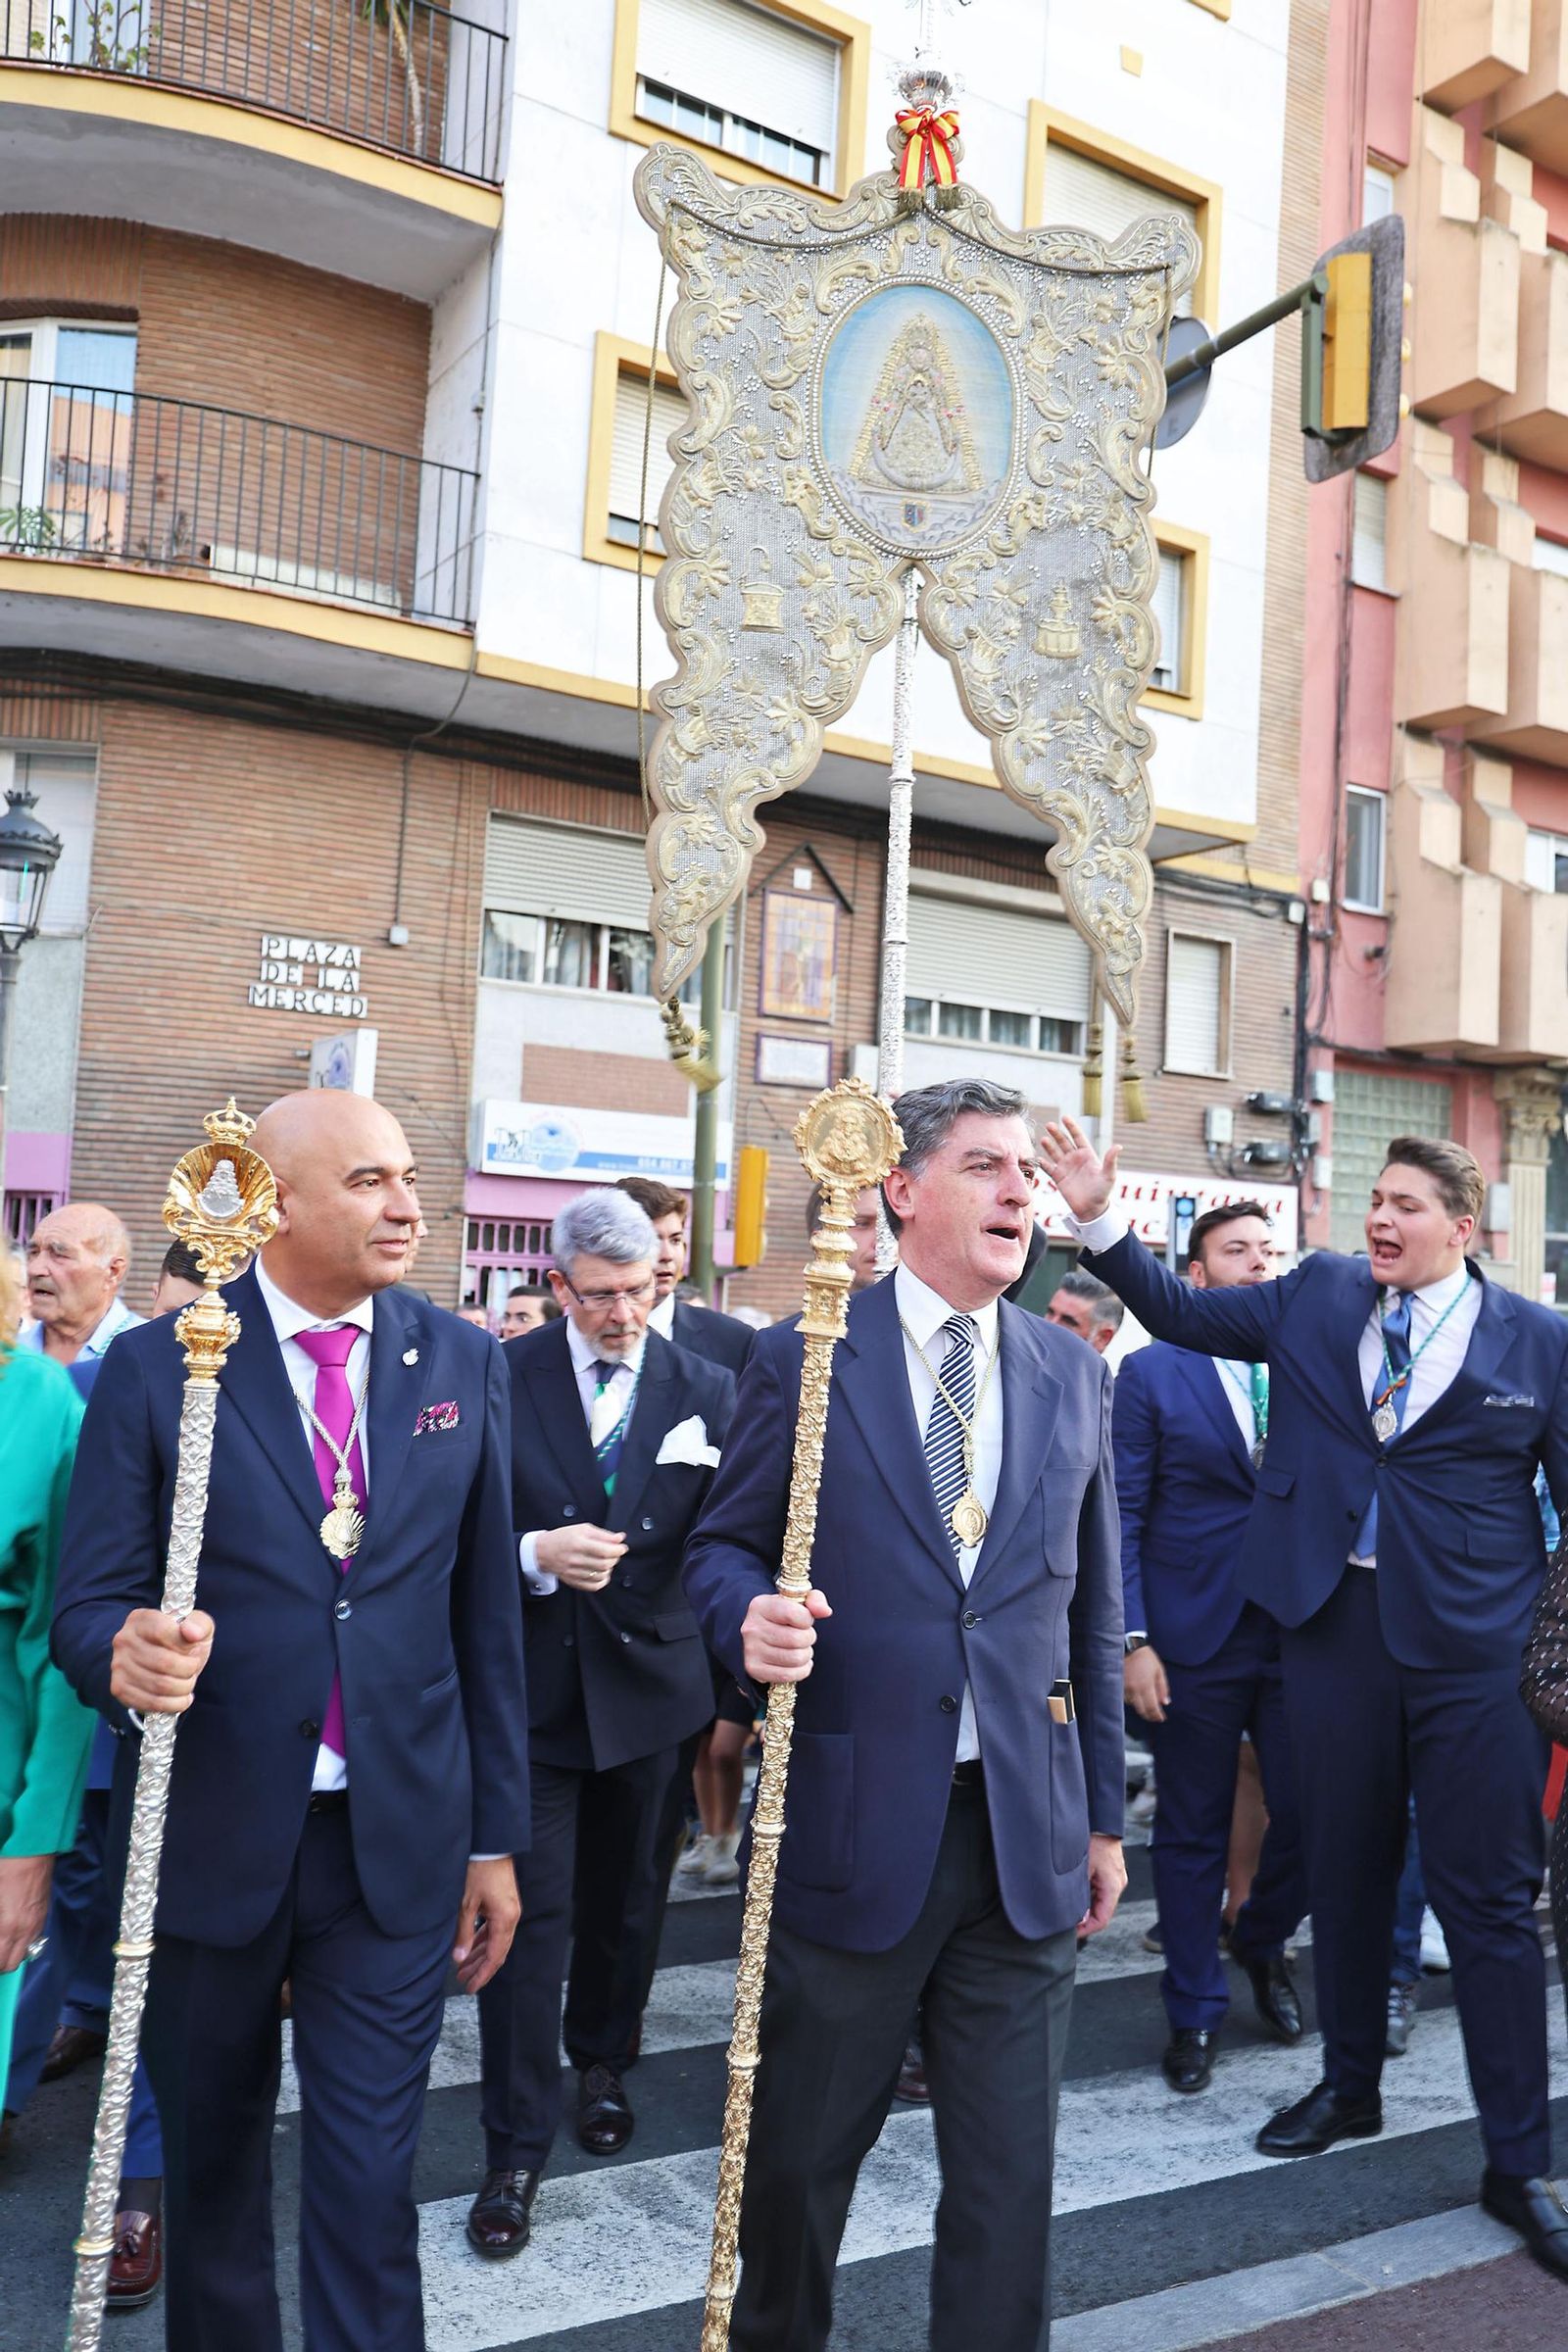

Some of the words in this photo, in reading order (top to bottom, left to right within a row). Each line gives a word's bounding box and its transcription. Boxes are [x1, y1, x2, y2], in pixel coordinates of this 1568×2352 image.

[264, 937, 359, 969] PLAZA
[264, 961, 301, 985] DE
[321, 967, 359, 994] LA
[251, 984, 366, 1017] MERCED
